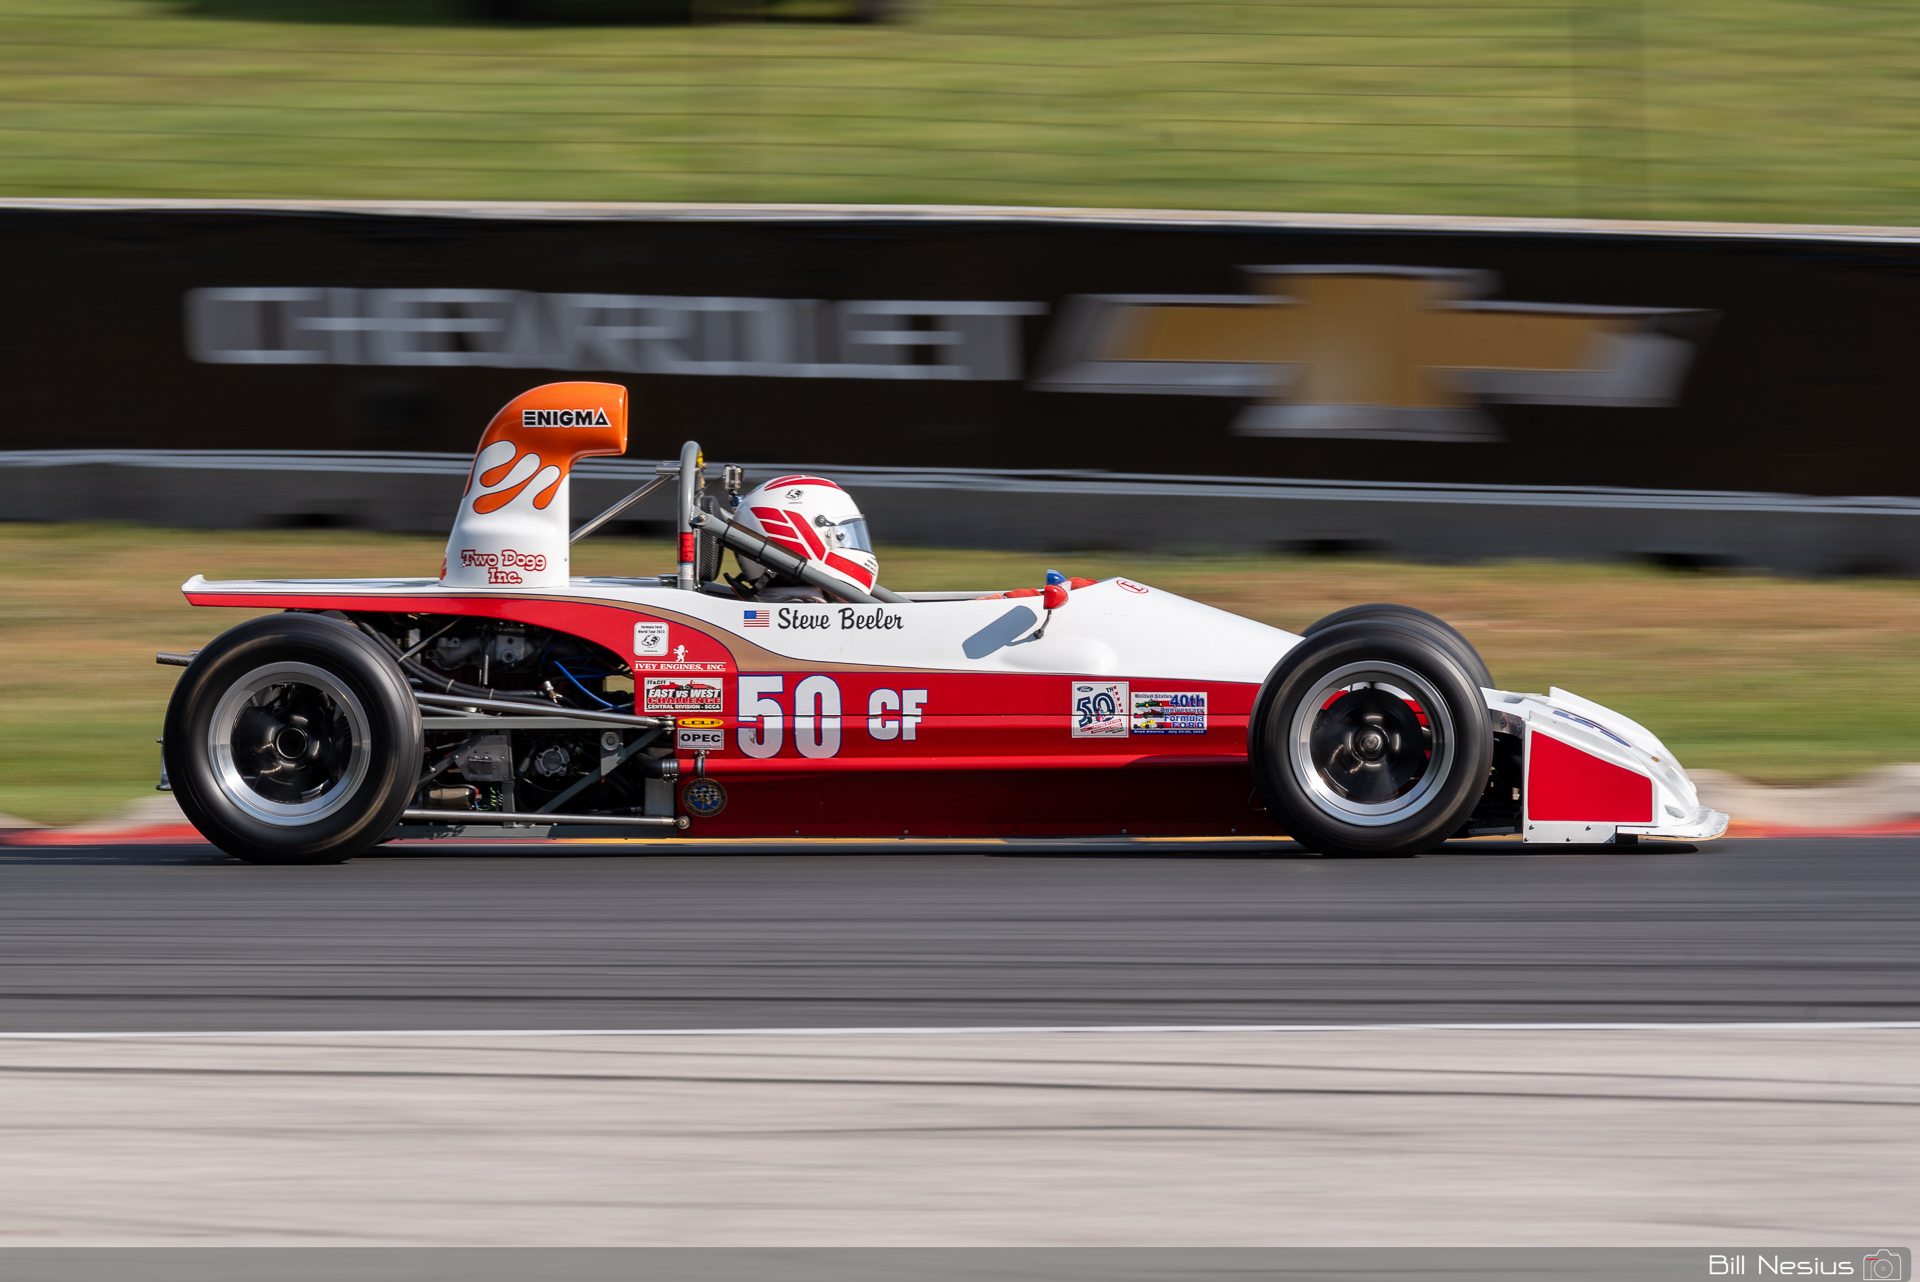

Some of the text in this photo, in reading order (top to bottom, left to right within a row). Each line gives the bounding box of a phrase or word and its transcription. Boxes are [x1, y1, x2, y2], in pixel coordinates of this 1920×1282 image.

[522, 406, 612, 428] ENIGMA
[461, 549, 498, 567] Two
[501, 548, 546, 571] Dogg
[488, 567, 522, 584] Inc.
[777, 607, 904, 630] Steve Beeler
[660, 663, 704, 671] ENGINES,
[648, 689, 675, 698] EAST
[690, 689, 721, 698] WEST
[647, 697, 721, 705] CHALLENGE
[1169, 694, 1205, 707] 40th
[736, 674, 928, 759] 50 CF
[1076, 692, 1115, 728] 50
[1163, 714, 1204, 722] Formula
[1172, 721, 1204, 729] FORD
[680, 733, 721, 743] OPEC
